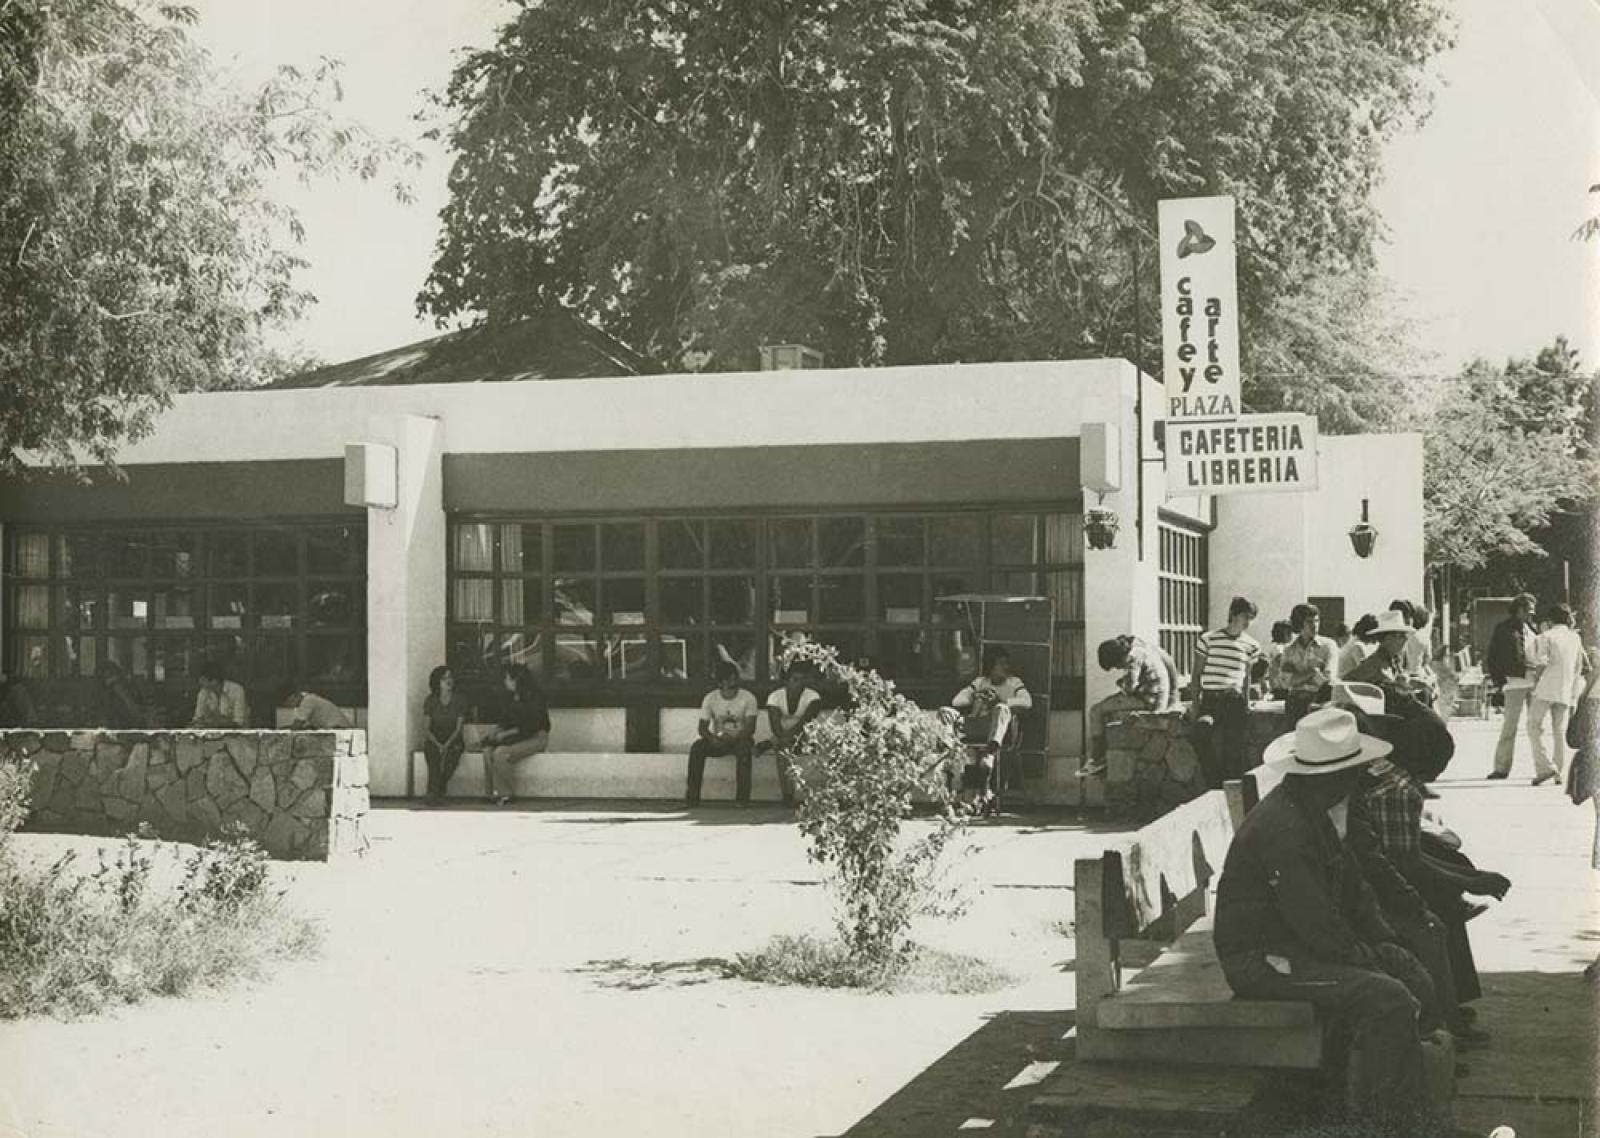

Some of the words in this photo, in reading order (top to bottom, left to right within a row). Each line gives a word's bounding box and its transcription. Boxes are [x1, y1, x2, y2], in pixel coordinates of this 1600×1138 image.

[1204, 297, 1224, 384] arte
[1170, 395, 1234, 417] PLAZA
[1187, 456, 1300, 487] LIBRERIA
